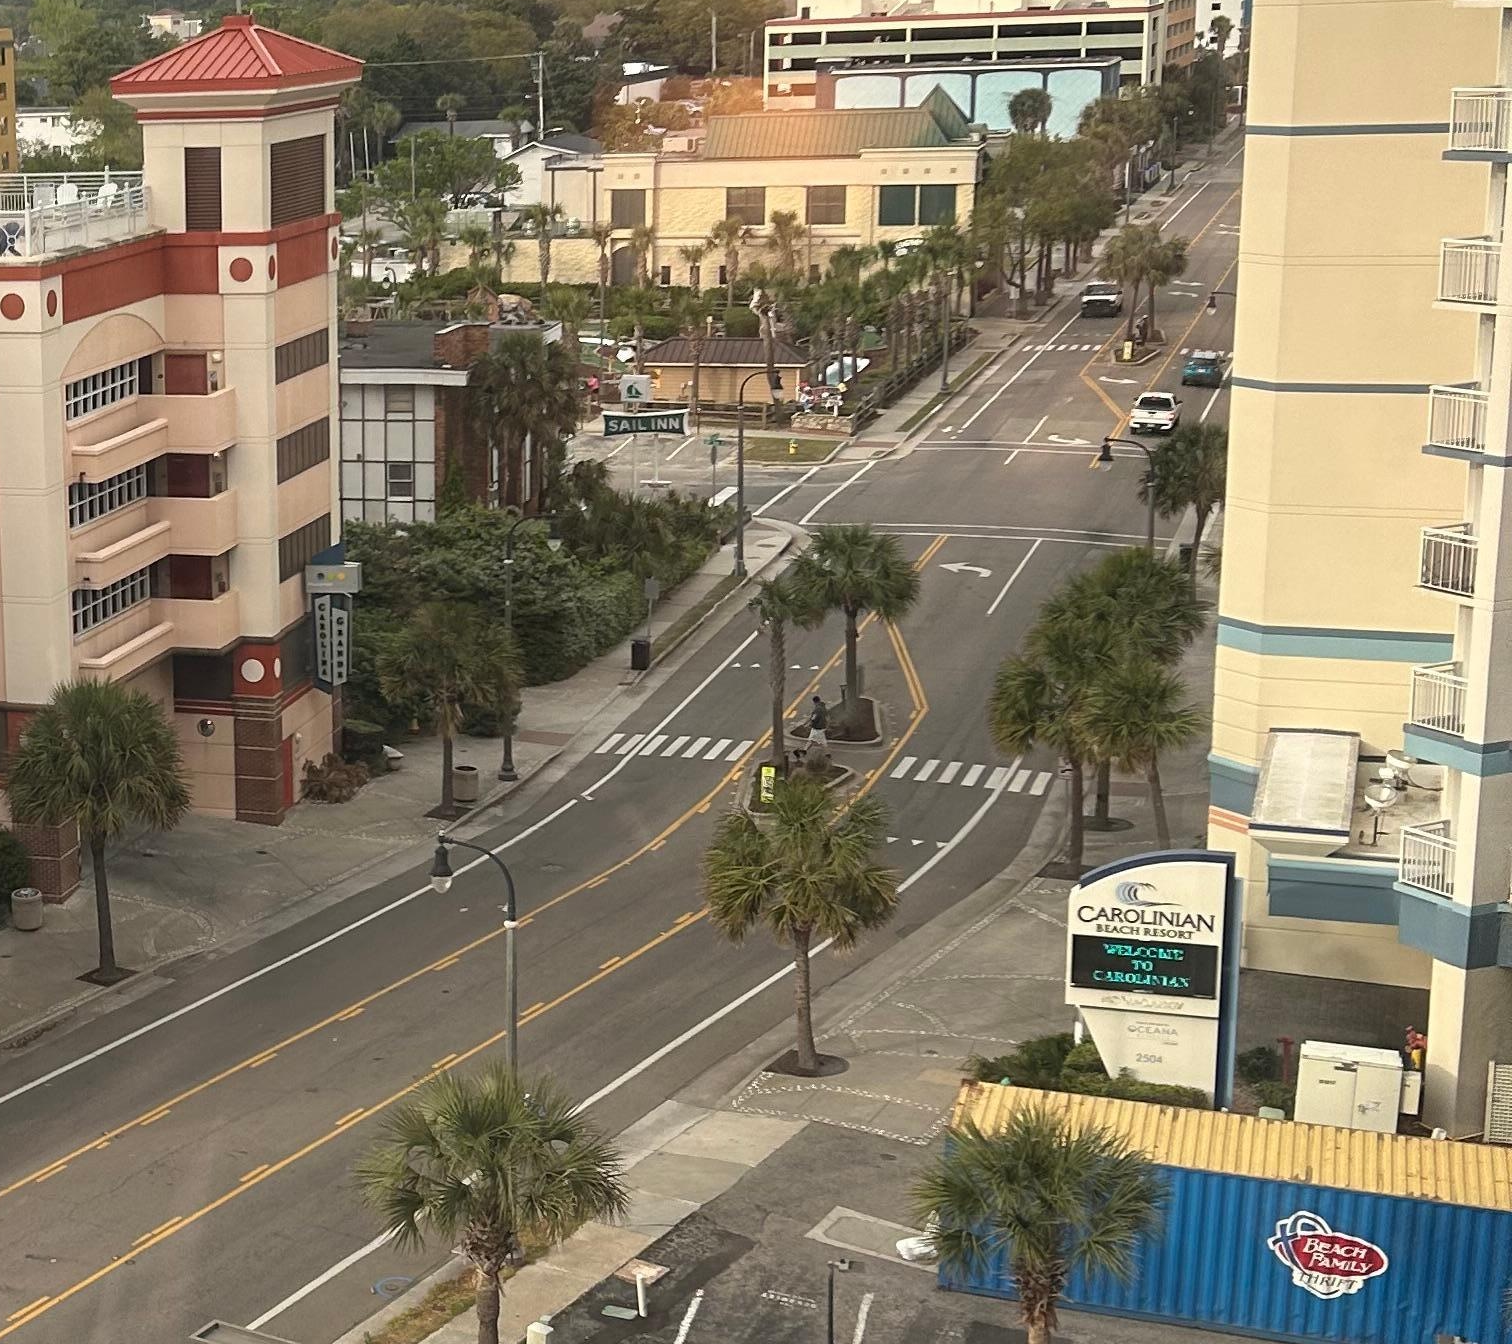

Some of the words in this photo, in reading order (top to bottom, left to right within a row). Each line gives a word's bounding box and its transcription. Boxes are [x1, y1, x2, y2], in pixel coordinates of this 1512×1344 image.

[608, 419, 647, 432] SAIL
[650, 417, 680, 430] INN
[318, 603, 328, 676] CAROLINA
[1078, 906, 1215, 932] CAROLINIAN
[1096, 924, 1140, 935] BEACH
[1143, 928, 1194, 939] RESORT
[1131, 959, 1154, 972] TO
[1128, 1025, 1178, 1035] OCEANA
[1135, 1053, 1163, 1064] 2504
[1302, 1238, 1368, 1259] BEACH
[1308, 1252, 1374, 1273] FAMILY
[1300, 1272, 1358, 1289] THRIFT
